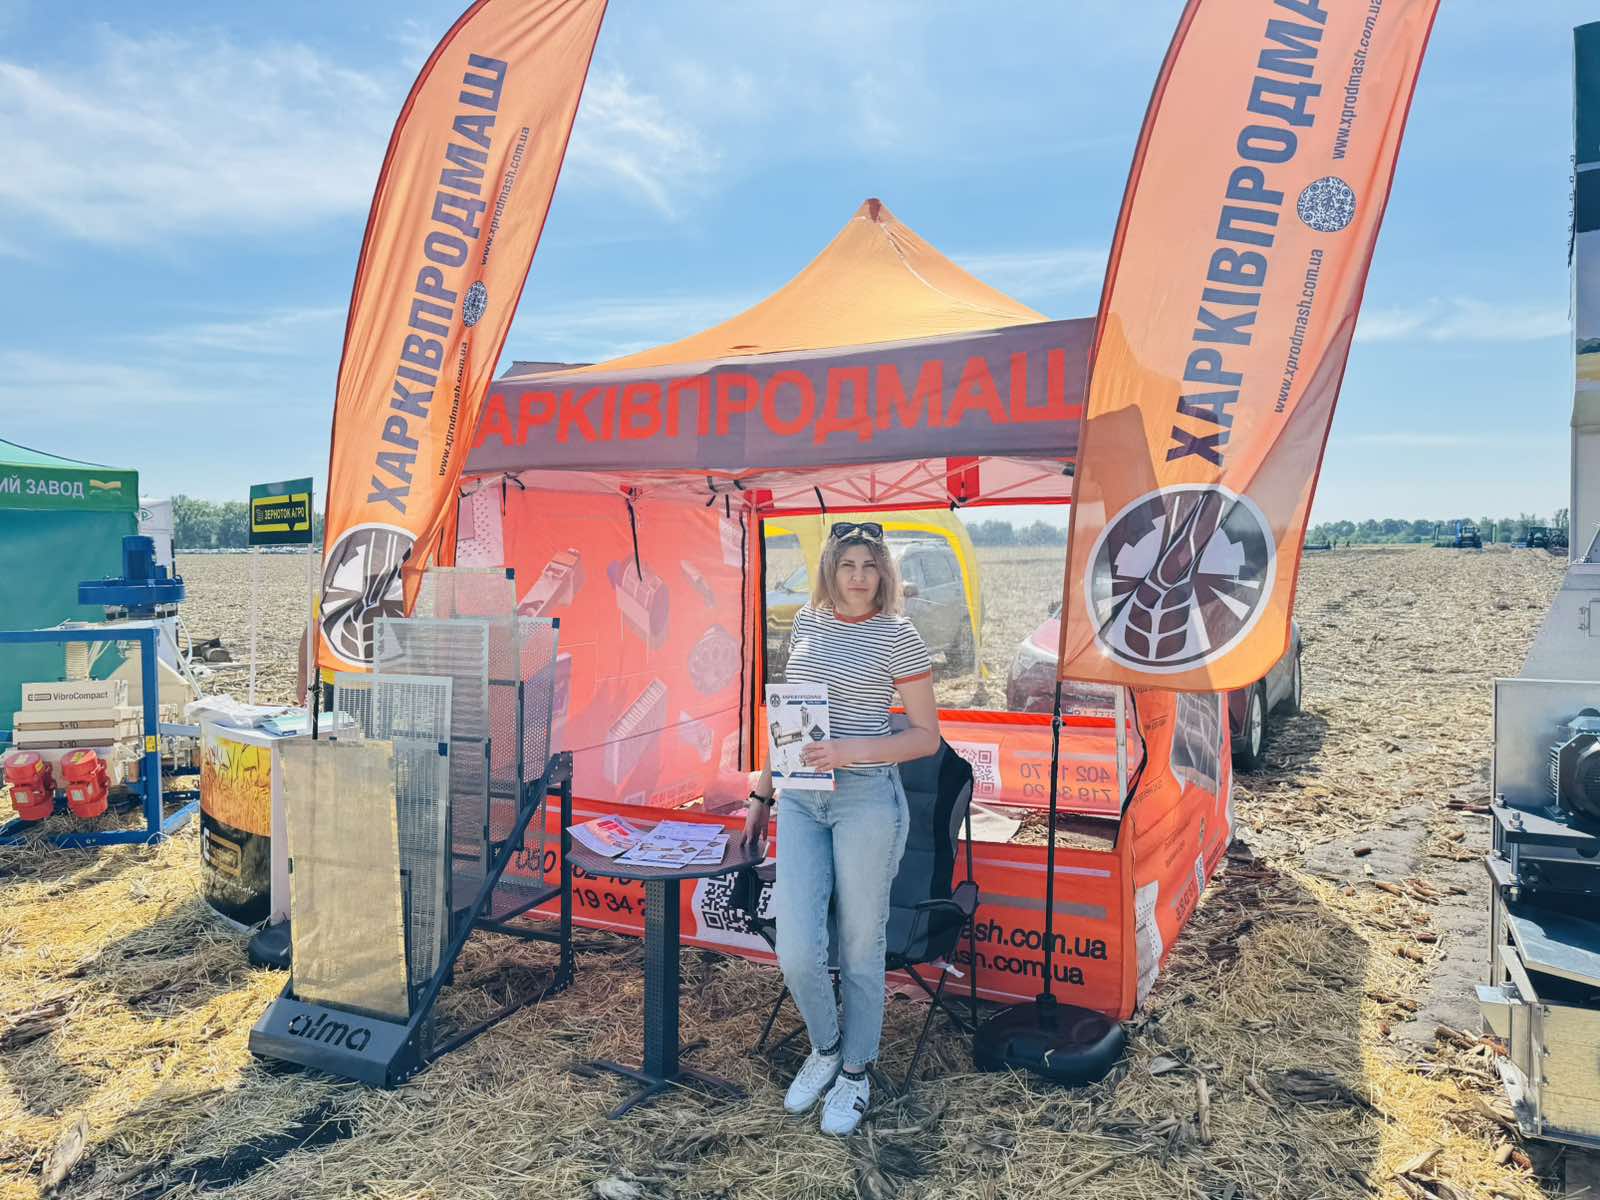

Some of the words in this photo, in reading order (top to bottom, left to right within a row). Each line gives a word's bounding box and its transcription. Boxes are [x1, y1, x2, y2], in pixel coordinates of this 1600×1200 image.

[1332, 0, 1383, 160] www.xprodmash.com.ua
[480, 126, 530, 267] www.xprodmash.com.ua
[367, 52, 508, 515] ХАРКІВПРОДМАШ
[1274, 248, 1324, 414] www.xprodmash.com.ua
[438, 342, 469, 478] www.xprodmash.com.ua
[471, 348, 1083, 449] АРКІВПРОДМАШ
[26, 479, 85, 499] ЗАВОД
[53, 690, 109, 702] VibroCompact
[573, 887, 601, 909] 19
[603, 892, 634, 916] 34
[961, 919, 1108, 961] ash.com.ua
[287, 1012, 372, 1052] alma
